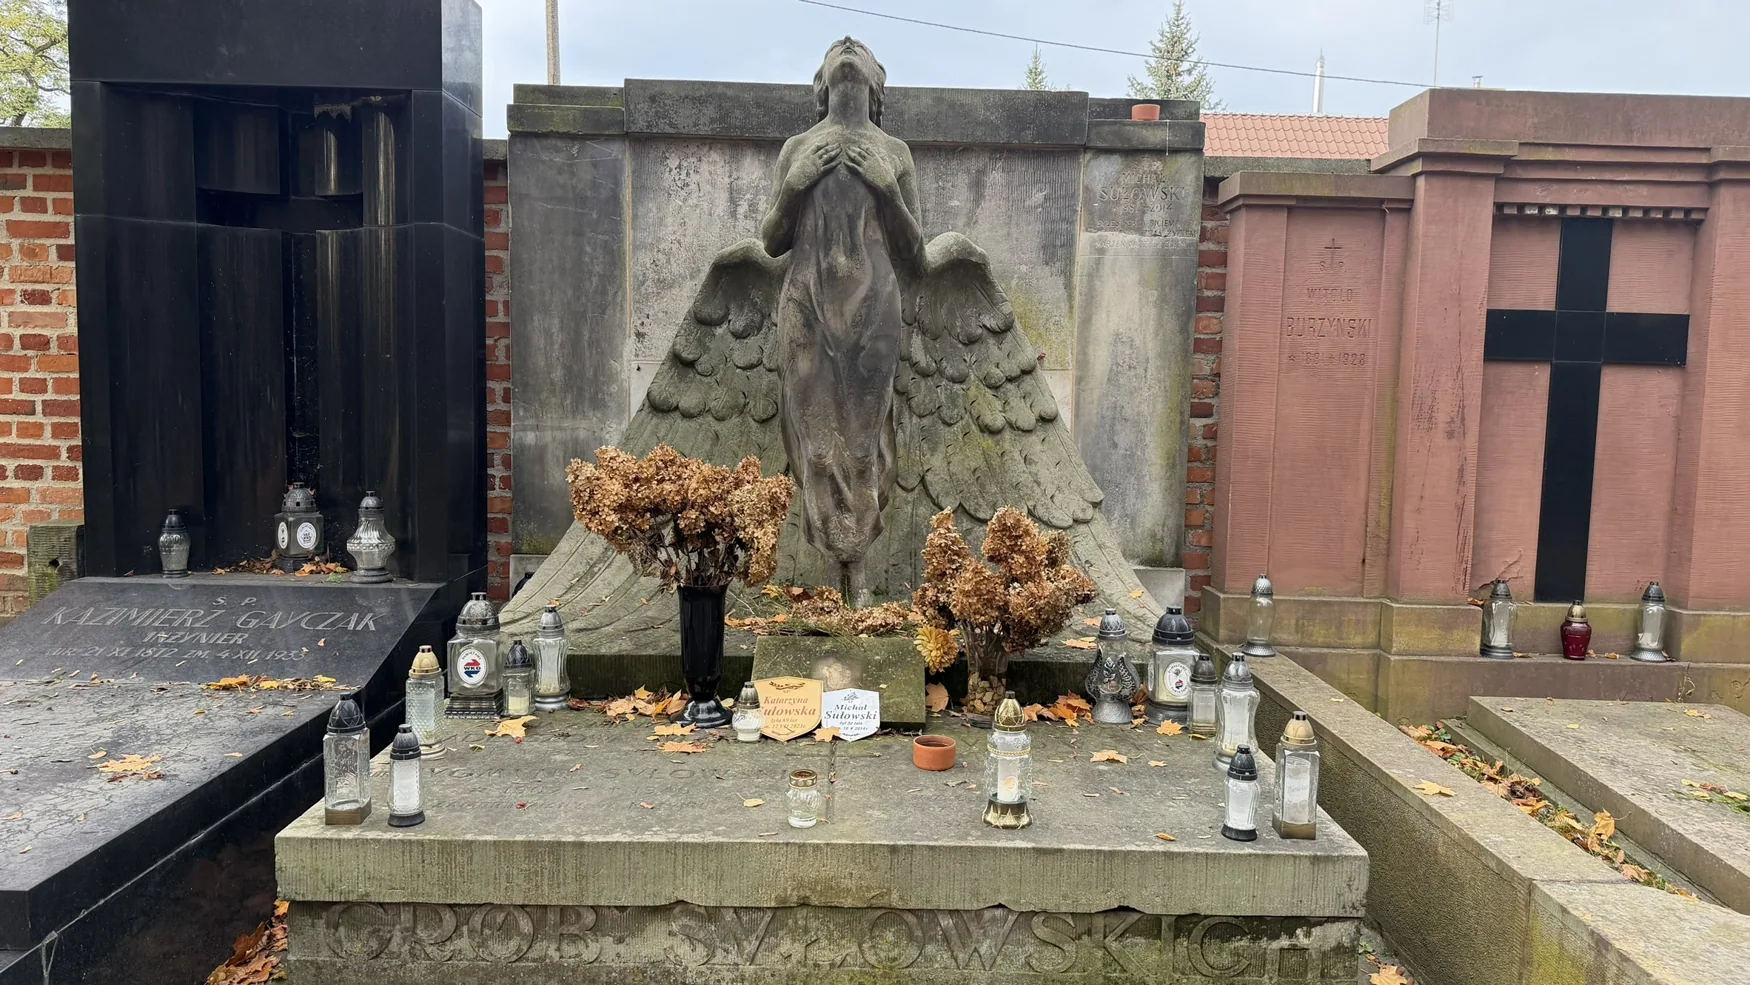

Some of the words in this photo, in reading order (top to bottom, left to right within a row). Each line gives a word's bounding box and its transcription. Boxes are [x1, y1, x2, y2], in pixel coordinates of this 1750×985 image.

[1099, 186, 1186, 201] SUŁOWSKI
[1307, 287, 1353, 302] WITOLD
[1286, 313, 1373, 339] BURZYŃSKI
[240, 596, 257, 606] P.
[39, 606, 226, 629] KAZIMIERZ
[235, 610, 386, 631] GAYCZAK
[82, 646, 107, 657] 21
[106, 647, 133, 657] XI
[132, 647, 179, 658] 1872
[216, 649, 230, 659] 4
[231, 649, 263, 660] XII
[264, 650, 306, 661] 1933
[763, 696, 809, 706] Katarzyna
[761, 705, 817, 716] ułowska
[824, 710, 878, 720] Sułowski
